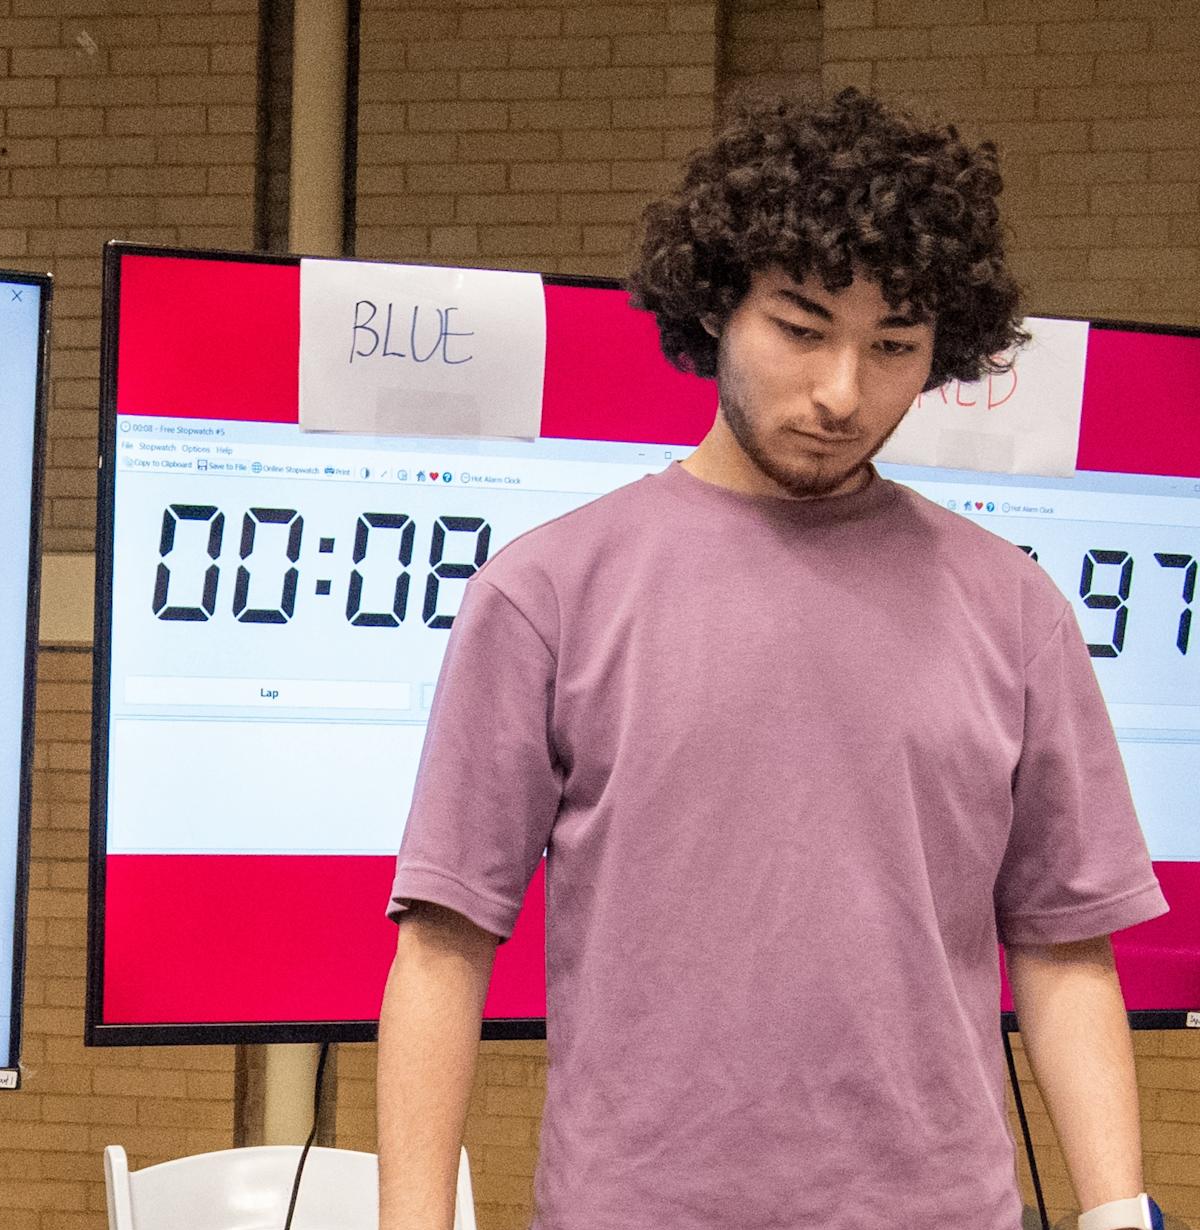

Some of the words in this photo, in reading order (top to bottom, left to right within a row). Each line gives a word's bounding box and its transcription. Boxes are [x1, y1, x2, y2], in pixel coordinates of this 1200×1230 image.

[349, 299, 475, 365] BLUE
[160, 425, 175, 434] Free
[176, 426, 214, 437] Stopwatch
[139, 442, 176, 452] Stopwatch
[182, 444, 210, 454] Options
[216, 446, 233, 455] Help
[161, 460, 192, 469] Clipboard
[152, 504, 491, 629] 00:08
[260, 687, 279, 699] Lap
